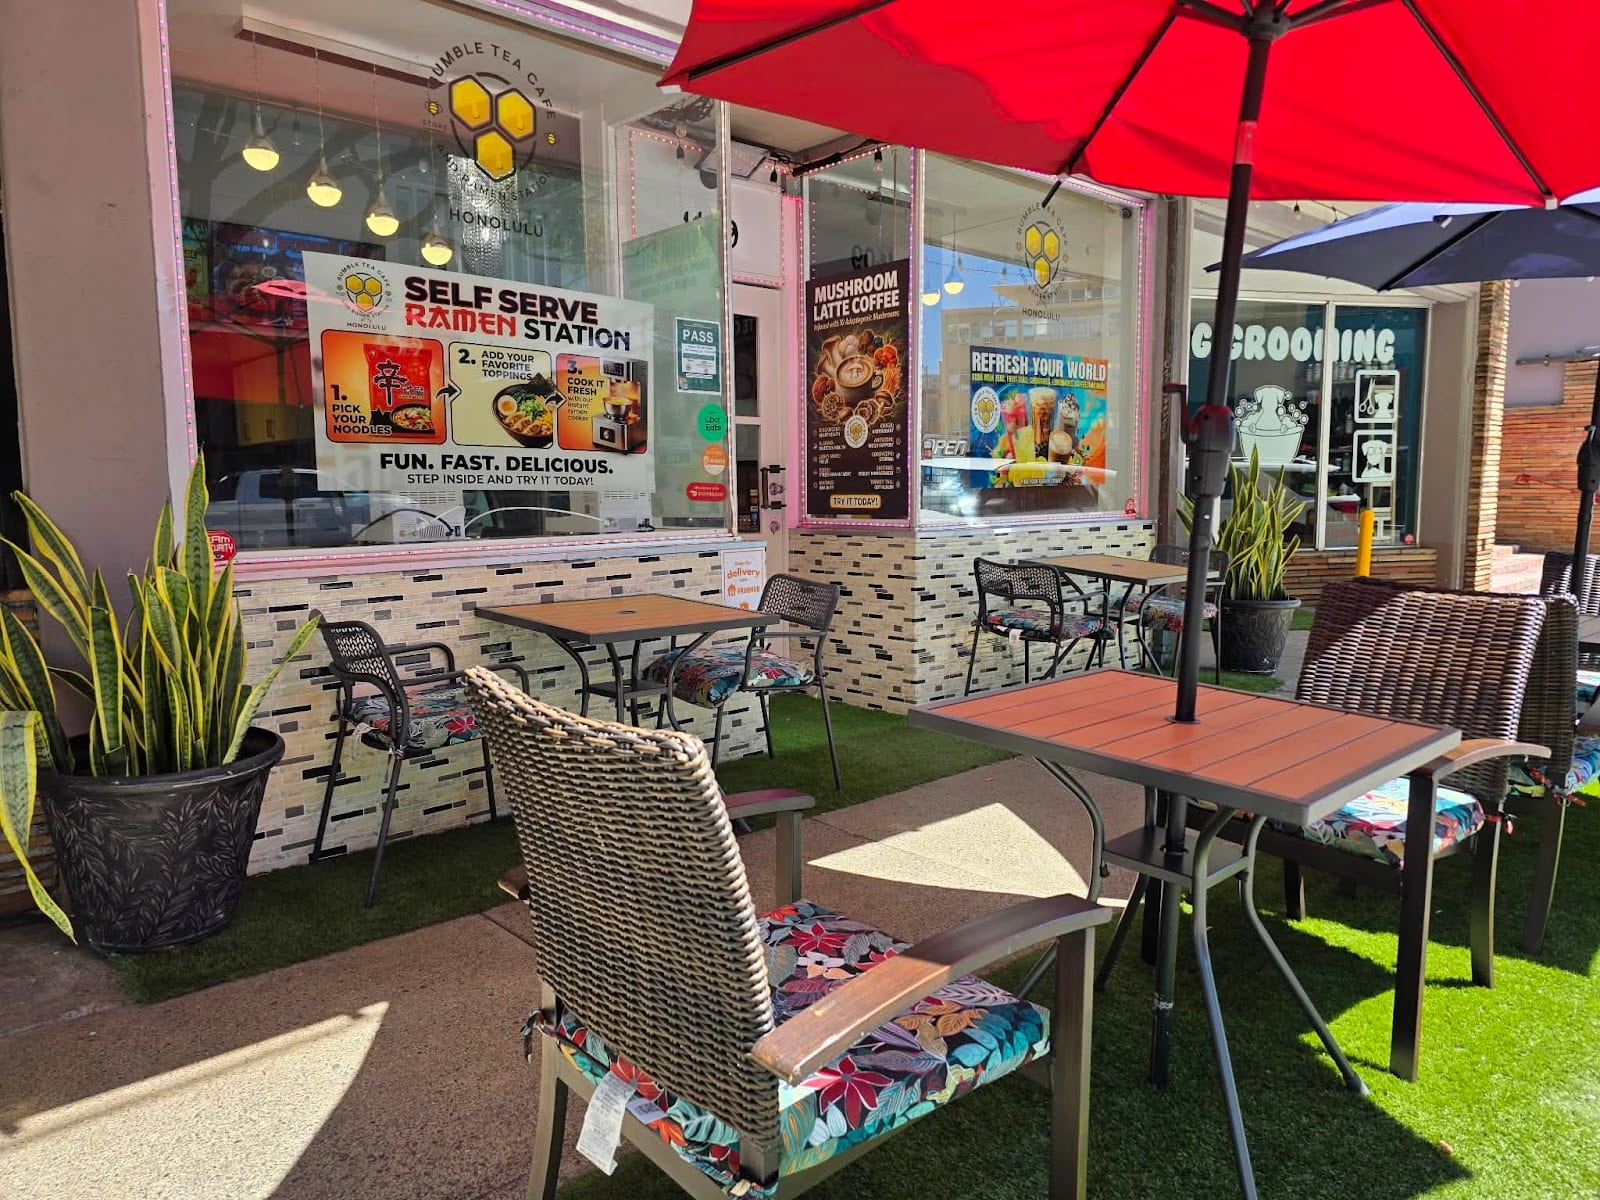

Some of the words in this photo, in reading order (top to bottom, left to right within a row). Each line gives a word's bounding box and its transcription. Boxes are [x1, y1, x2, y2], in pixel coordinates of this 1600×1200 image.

[491, 44, 522, 71] TEA
[527, 72, 556, 120] CAFE
[450, 208, 544, 237] HONOLULU
[814, 270, 898, 304] MUSHROOM
[404, 276, 493, 309] SELF
[498, 289, 598, 325] SERVE
[813, 299, 850, 322] LATTE
[851, 289, 900, 314] COFFEE
[1022, 306, 1060, 321] HONOLULU
[347, 322, 387, 331] HONOLULU
[404, 303, 517, 337] RAMEN
[524, 318, 630, 351] STATION
[682, 329, 714, 343] PASS
[458, 348, 476, 364] 2.
[481, 350, 505, 360] ADD
[506, 352, 534, 363] YOUR
[482, 360, 531, 371] FAVORITE
[567, 359, 583, 375] 3.
[972, 351, 1028, 375] REFRESH
[1032, 357, 1064, 378] YOUR
[1067, 361, 1106, 382] WORLD
[482, 369, 533, 380] TOPPINGS
[567, 377, 594, 387] COOK
[596, 380, 605, 388] IT
[330, 384, 348, 401] 1.
[567, 386, 597, 396] FRESH
[332, 404, 361, 413] PICK
[332, 414, 366, 424] YOUR
[333, 425, 392, 435] NOODLES
[380, 453, 434, 470] FUN.
[441, 454, 500, 471] FAST.
[506, 456, 614, 474] DELICIOUS.
[407, 474, 439, 484] STEP
[443, 474, 484, 484] INSIDE
[487, 475, 513, 485] AND
[516, 475, 538, 485] TRY
[541, 476, 551, 485] IT
[554, 476, 594, 486] TODAY!
[833, 497, 846, 505] TRY
[854, 498, 878, 506] TODAY!
[727, 568, 760, 579] delivery
